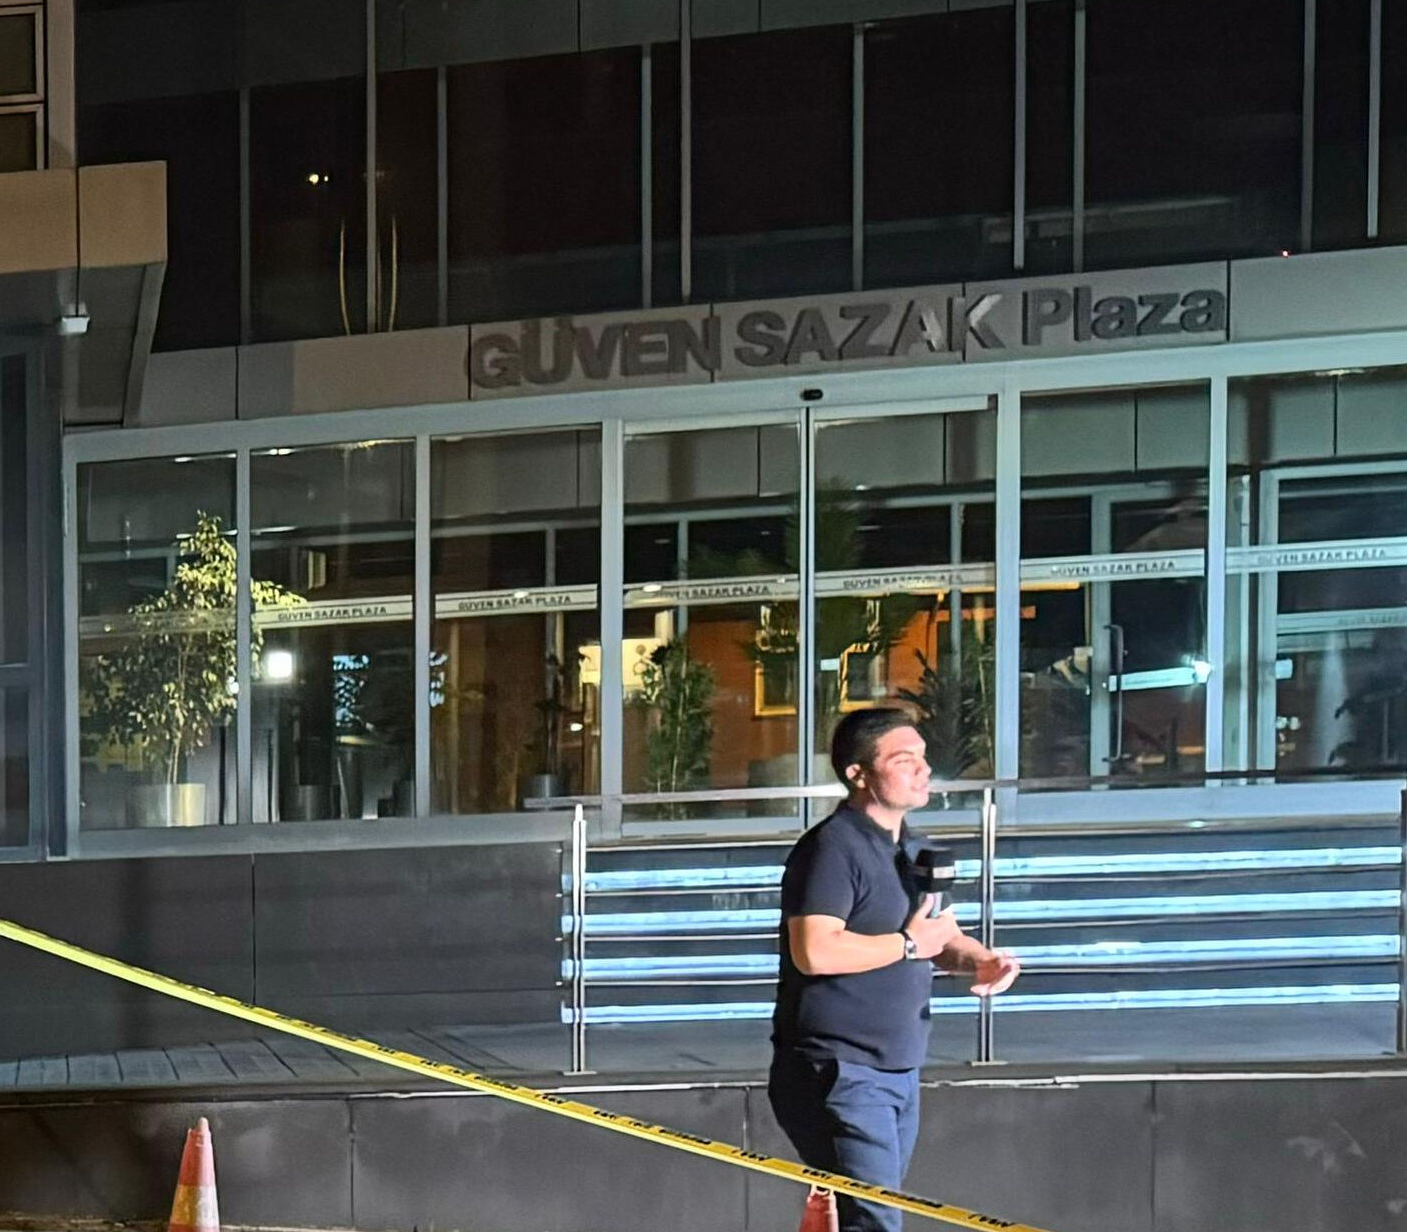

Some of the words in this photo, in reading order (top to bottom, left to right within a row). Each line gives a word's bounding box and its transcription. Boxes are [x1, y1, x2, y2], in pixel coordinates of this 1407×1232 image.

[470, 314, 720, 388] GÜVEN
[733, 293, 1005, 371] SAZAK
[1021, 283, 1227, 349] Plaza
